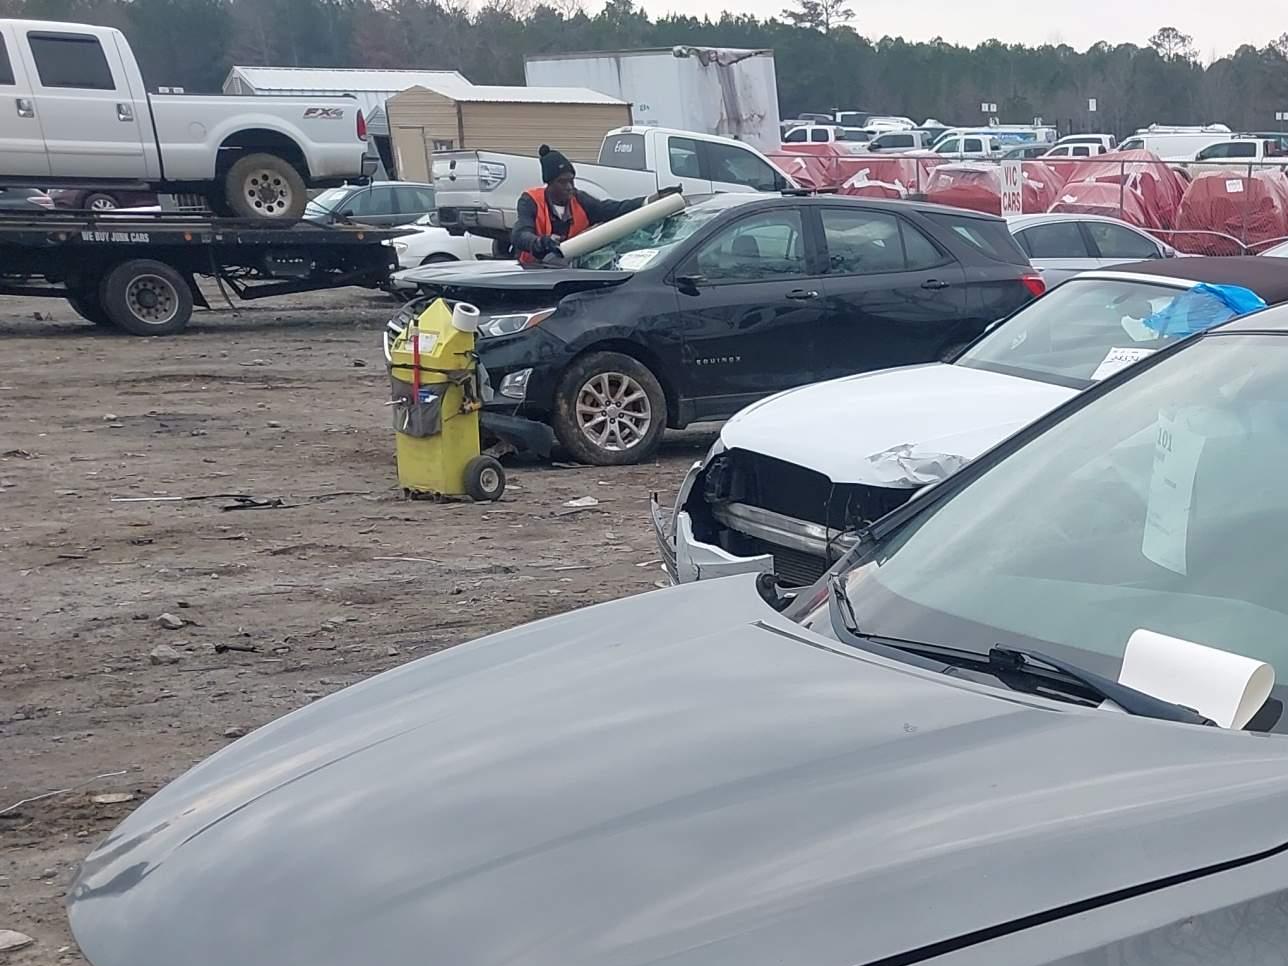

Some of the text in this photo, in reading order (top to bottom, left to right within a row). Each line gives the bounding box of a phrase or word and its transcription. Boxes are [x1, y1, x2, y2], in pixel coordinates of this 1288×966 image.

[1004, 166, 1017, 187] VIC
[1002, 191, 1020, 212] CARS
[81, 231, 94, 241] WE
[130, 232, 149, 243] CARS
[696, 356, 741, 366] EQUINOX
